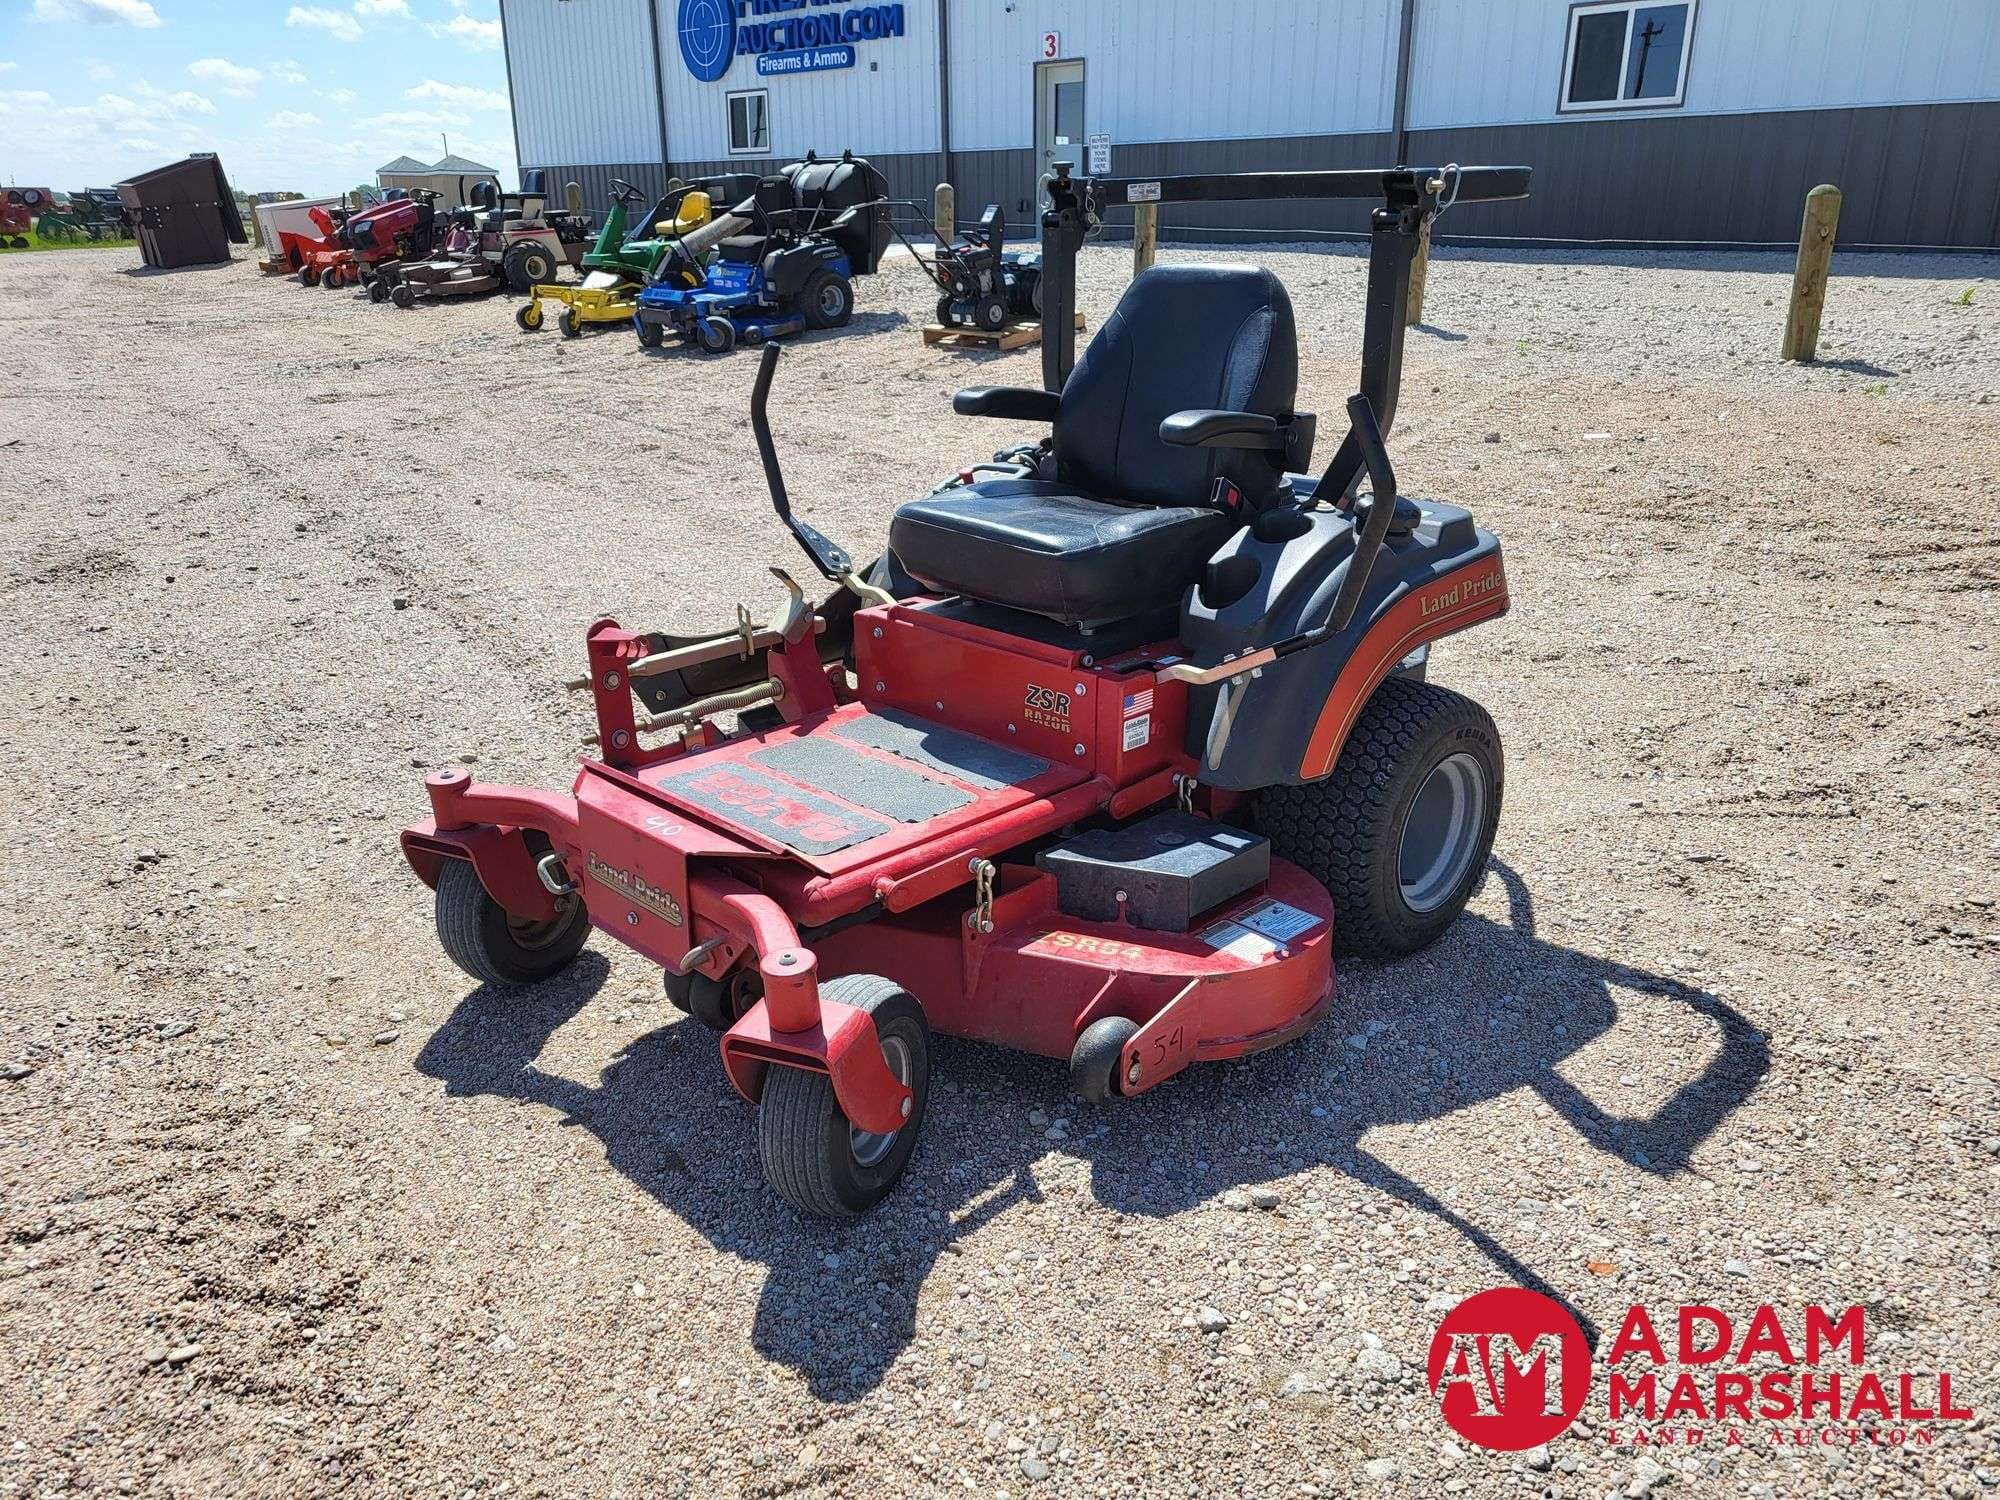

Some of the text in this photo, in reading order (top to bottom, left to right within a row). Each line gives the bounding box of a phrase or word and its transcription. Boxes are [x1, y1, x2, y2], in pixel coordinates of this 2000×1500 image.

[736, 4, 904, 55] AUCTION.COM
[1045, 34, 1057, 58] 3
[759, 51, 848, 72] Firearms & Ammo
[1420, 571, 1502, 617] Land Pride
[1025, 684, 1070, 717] ZSR
[1025, 708, 1071, 733] RAZOR
[588, 851, 682, 918] Land Pride
[1153, 1025, 1184, 1066] 54
